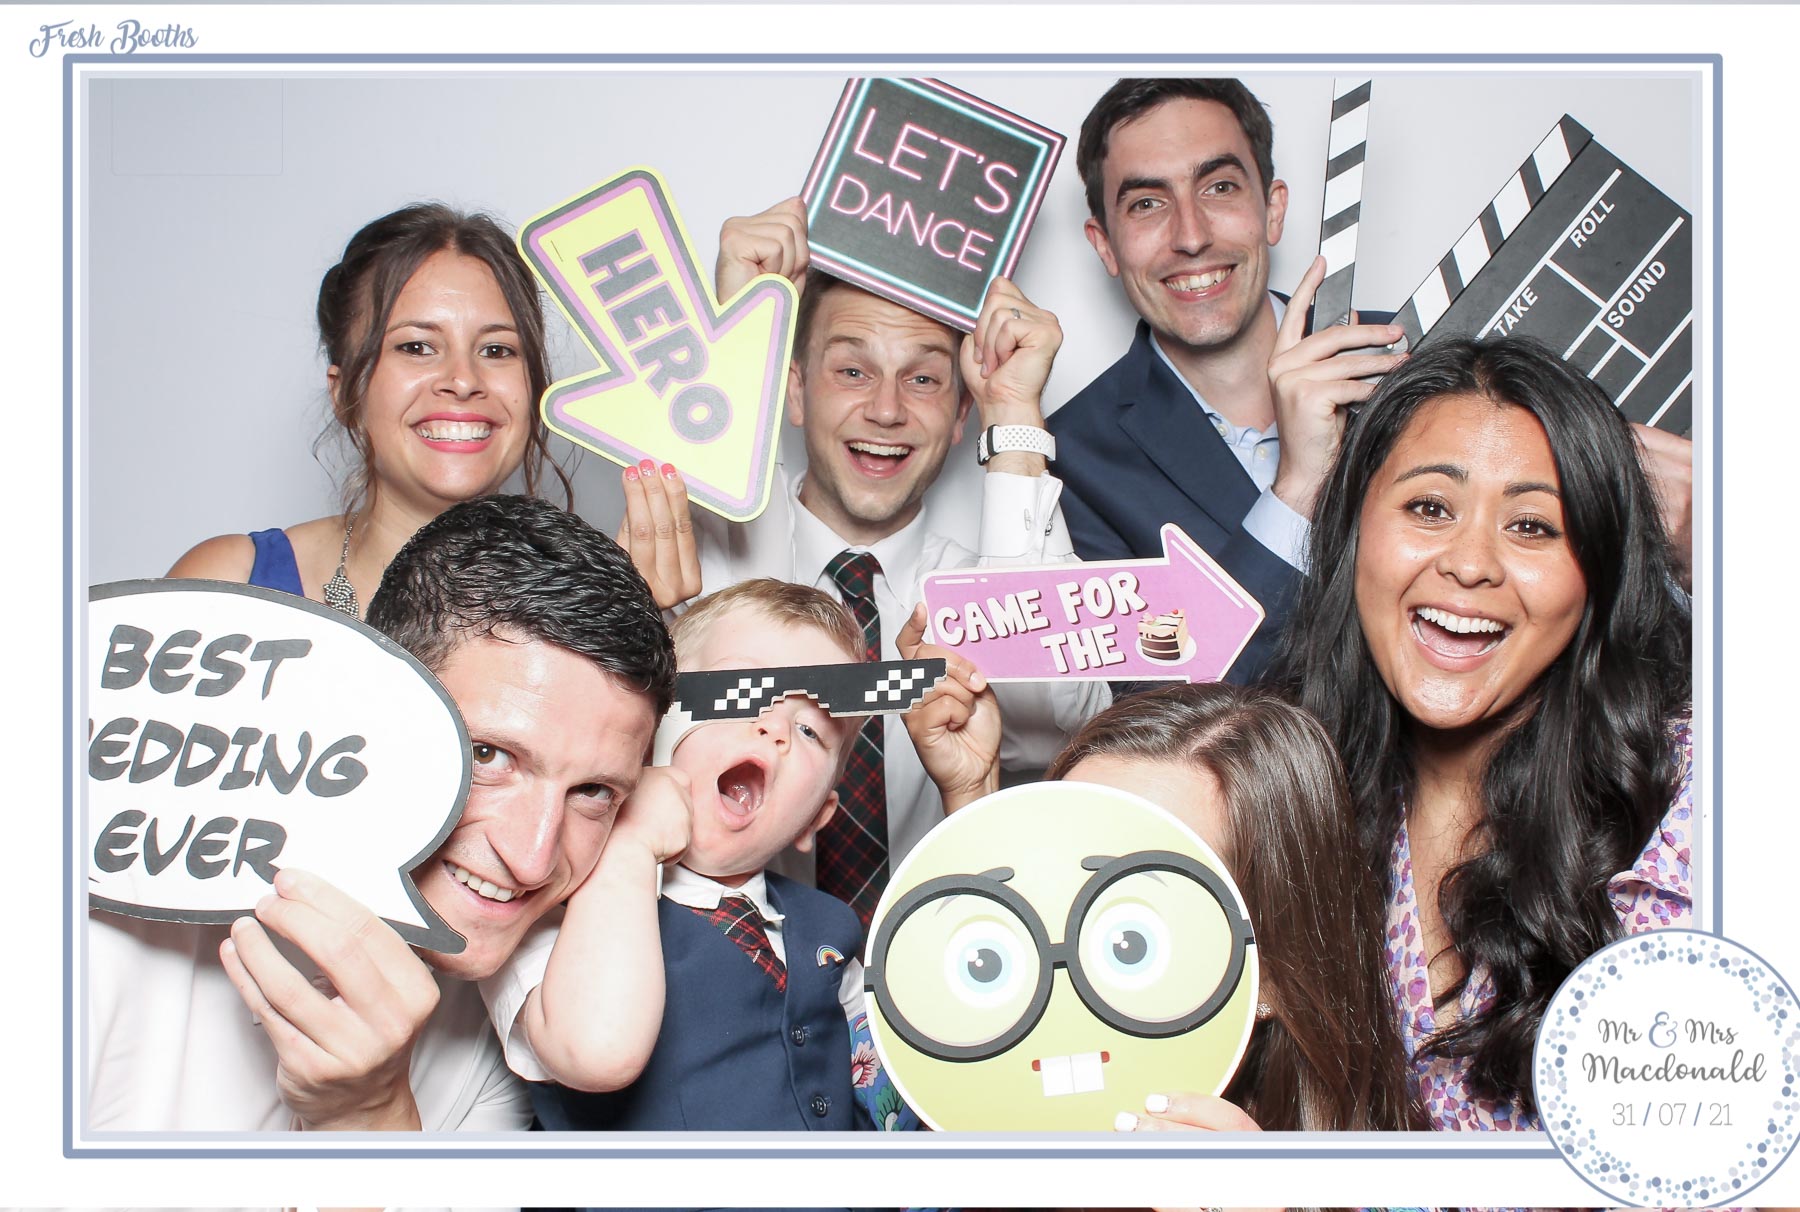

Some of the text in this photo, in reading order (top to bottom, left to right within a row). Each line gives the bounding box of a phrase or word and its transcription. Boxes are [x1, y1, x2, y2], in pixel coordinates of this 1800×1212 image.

[853, 107, 1018, 214] LET'S
[829, 174, 994, 272] DANCE
[1569, 199, 1615, 249] ROLL
[1493, 286, 1538, 337] TAKE
[1607, 260, 1666, 329] SOUND
[577, 228, 733, 444] HERO
[934, 571, 1149, 646] CAME FOR
[101, 624, 312, 700] BEST
[1040, 623, 1126, 674] THE
[89, 717, 368, 797] EDDING
[94, 810, 287, 885] EVER
